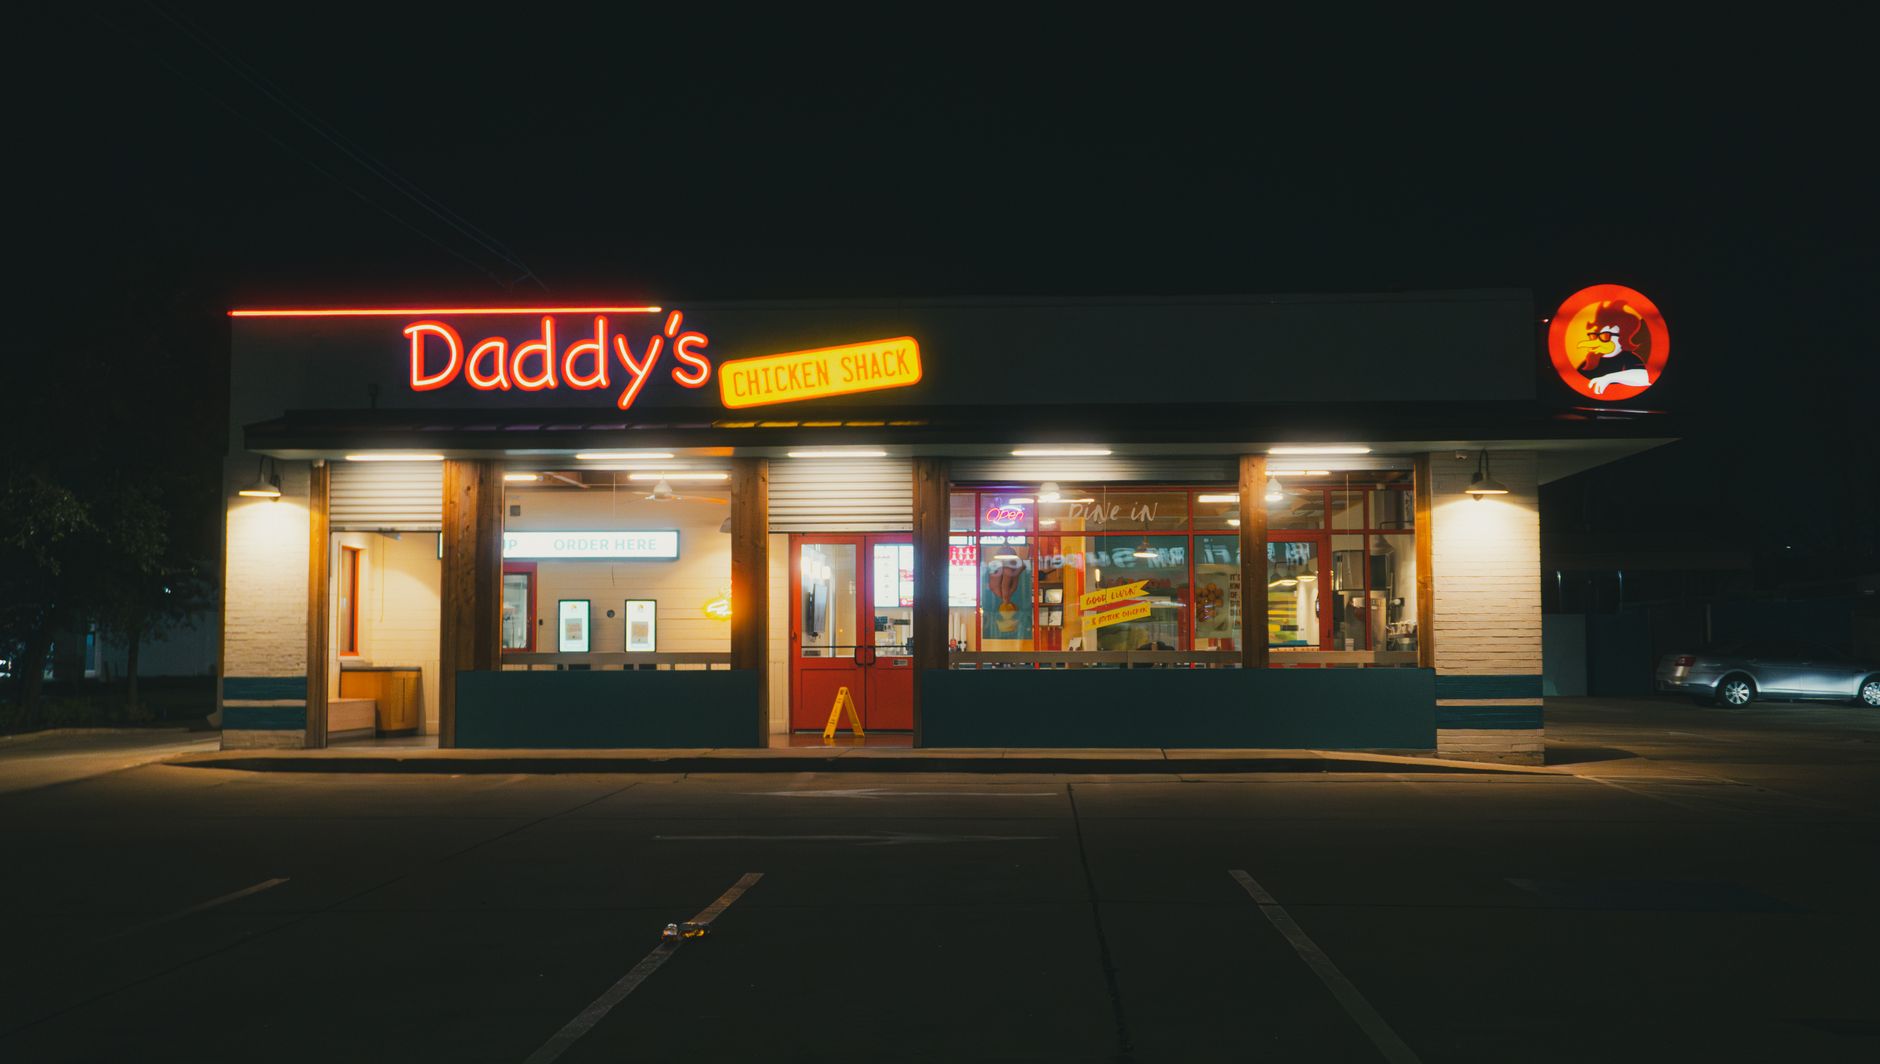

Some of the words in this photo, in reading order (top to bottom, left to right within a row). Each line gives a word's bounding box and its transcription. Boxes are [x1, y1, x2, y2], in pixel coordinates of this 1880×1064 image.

[403, 310, 711, 411] Daddy's
[732, 359, 830, 398] CHICKEN
[840, 348, 911, 382] SHACK
[986, 507, 1025, 523] Open
[553, 538, 609, 551] ORDER
[615, 538, 657, 551] HERE
[1086, 594, 1107, 605] GOOD
